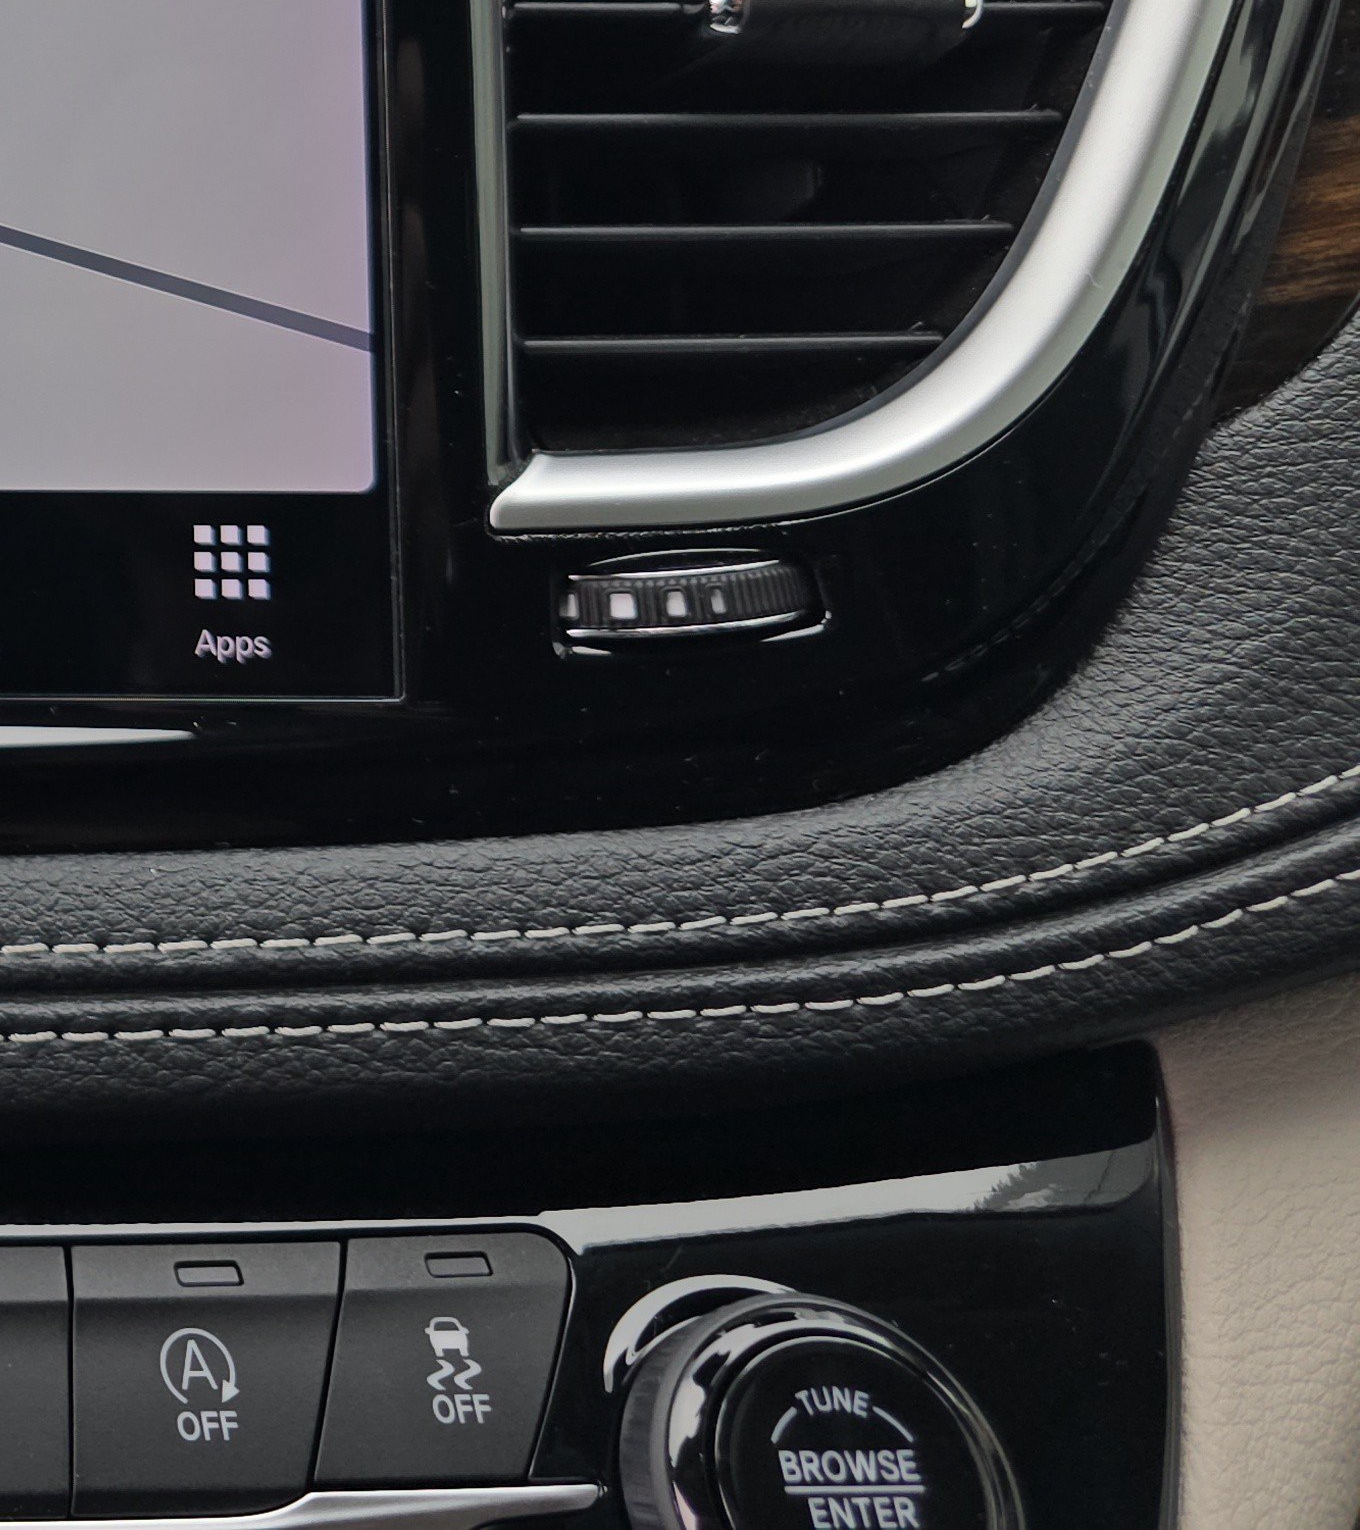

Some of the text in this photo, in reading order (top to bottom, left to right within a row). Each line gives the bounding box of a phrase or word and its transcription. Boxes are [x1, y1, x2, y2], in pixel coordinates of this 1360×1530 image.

[194, 628, 272, 664] Apps
[432, 1393, 492, 1424] OFF
[794, 1385, 870, 1419] TUNE
[176, 1410, 239, 1441] OFF
[778, 1449, 922, 1483] BROWSE
[807, 1496, 921, 1530] ENTER
